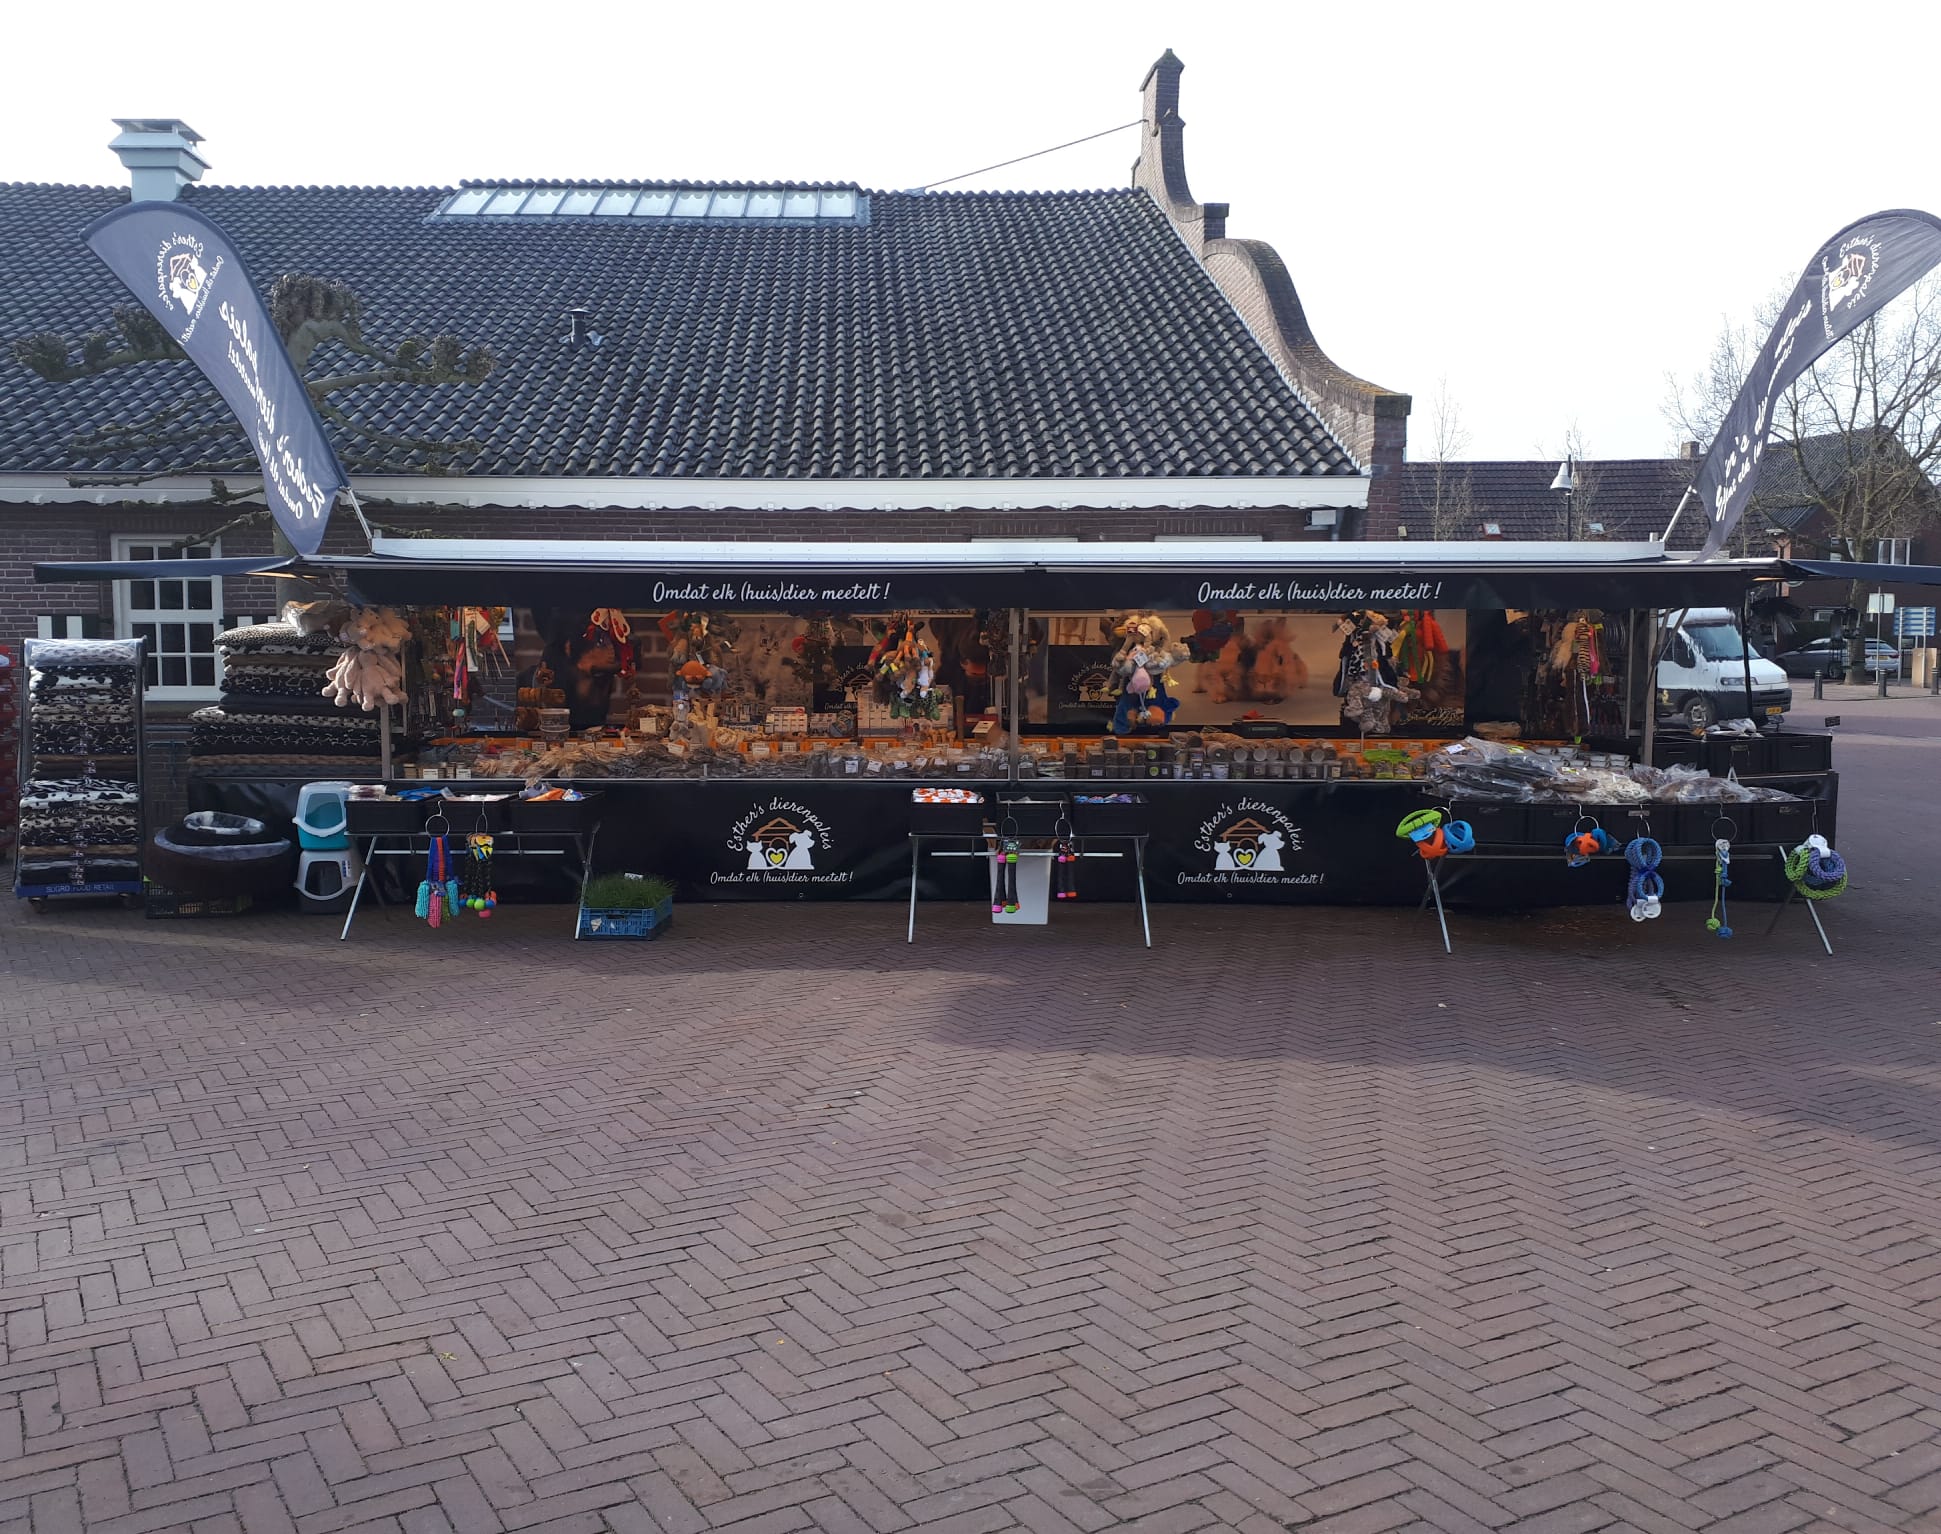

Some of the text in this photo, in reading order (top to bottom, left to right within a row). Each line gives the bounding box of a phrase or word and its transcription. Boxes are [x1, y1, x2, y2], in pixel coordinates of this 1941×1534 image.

[652, 581, 710, 603] Omdat
[712, 583, 736, 601] elk
[740, 580, 818, 603] (huis)dier
[1197, 581, 1258, 603] Omdat
[1258, 583, 1284, 601] elk
[1287, 580, 1367, 603] (huis)dier
[727, 797, 835, 852] Esther's dierenpaleis
[1194, 797, 1305, 852] Esther's dierenpaleis
[710, 872, 744, 884] Omdat
[746, 872, 760, 883] elk
[763, 872, 809, 884] (huis)dier
[1177, 872, 1212, 885] Omdat
[1213, 873, 1228, 884] elk
[1230, 872, 1279, 884] (huis)dier
